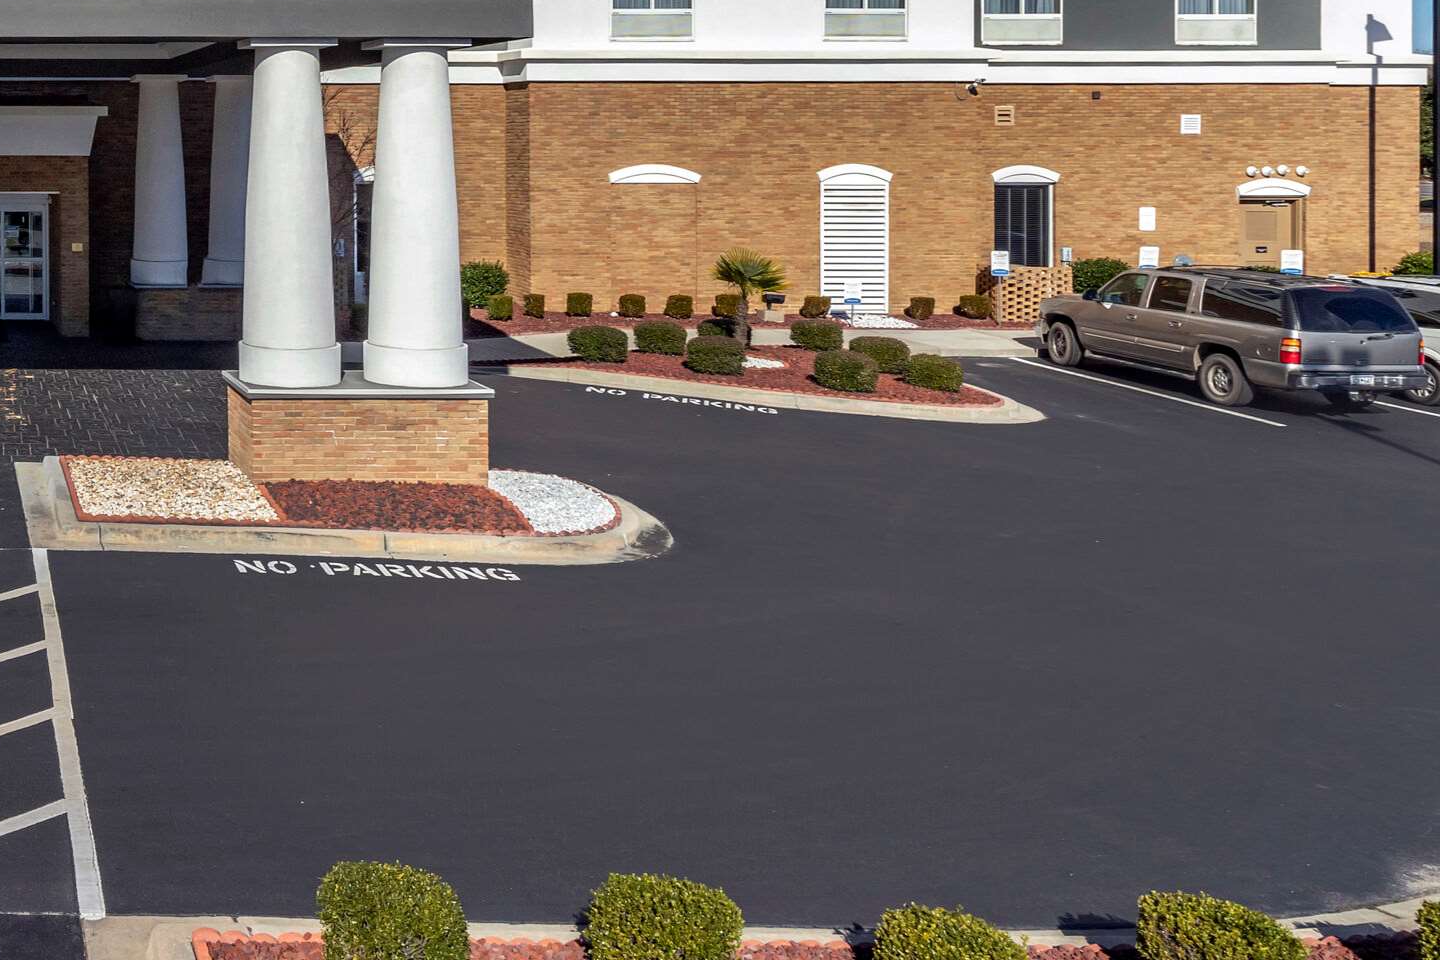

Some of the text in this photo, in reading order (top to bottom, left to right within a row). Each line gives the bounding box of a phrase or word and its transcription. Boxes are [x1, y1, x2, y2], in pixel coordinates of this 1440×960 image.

[585, 386, 779, 415] NO PARKING
[232, 559, 521, 581] NO PARKING
